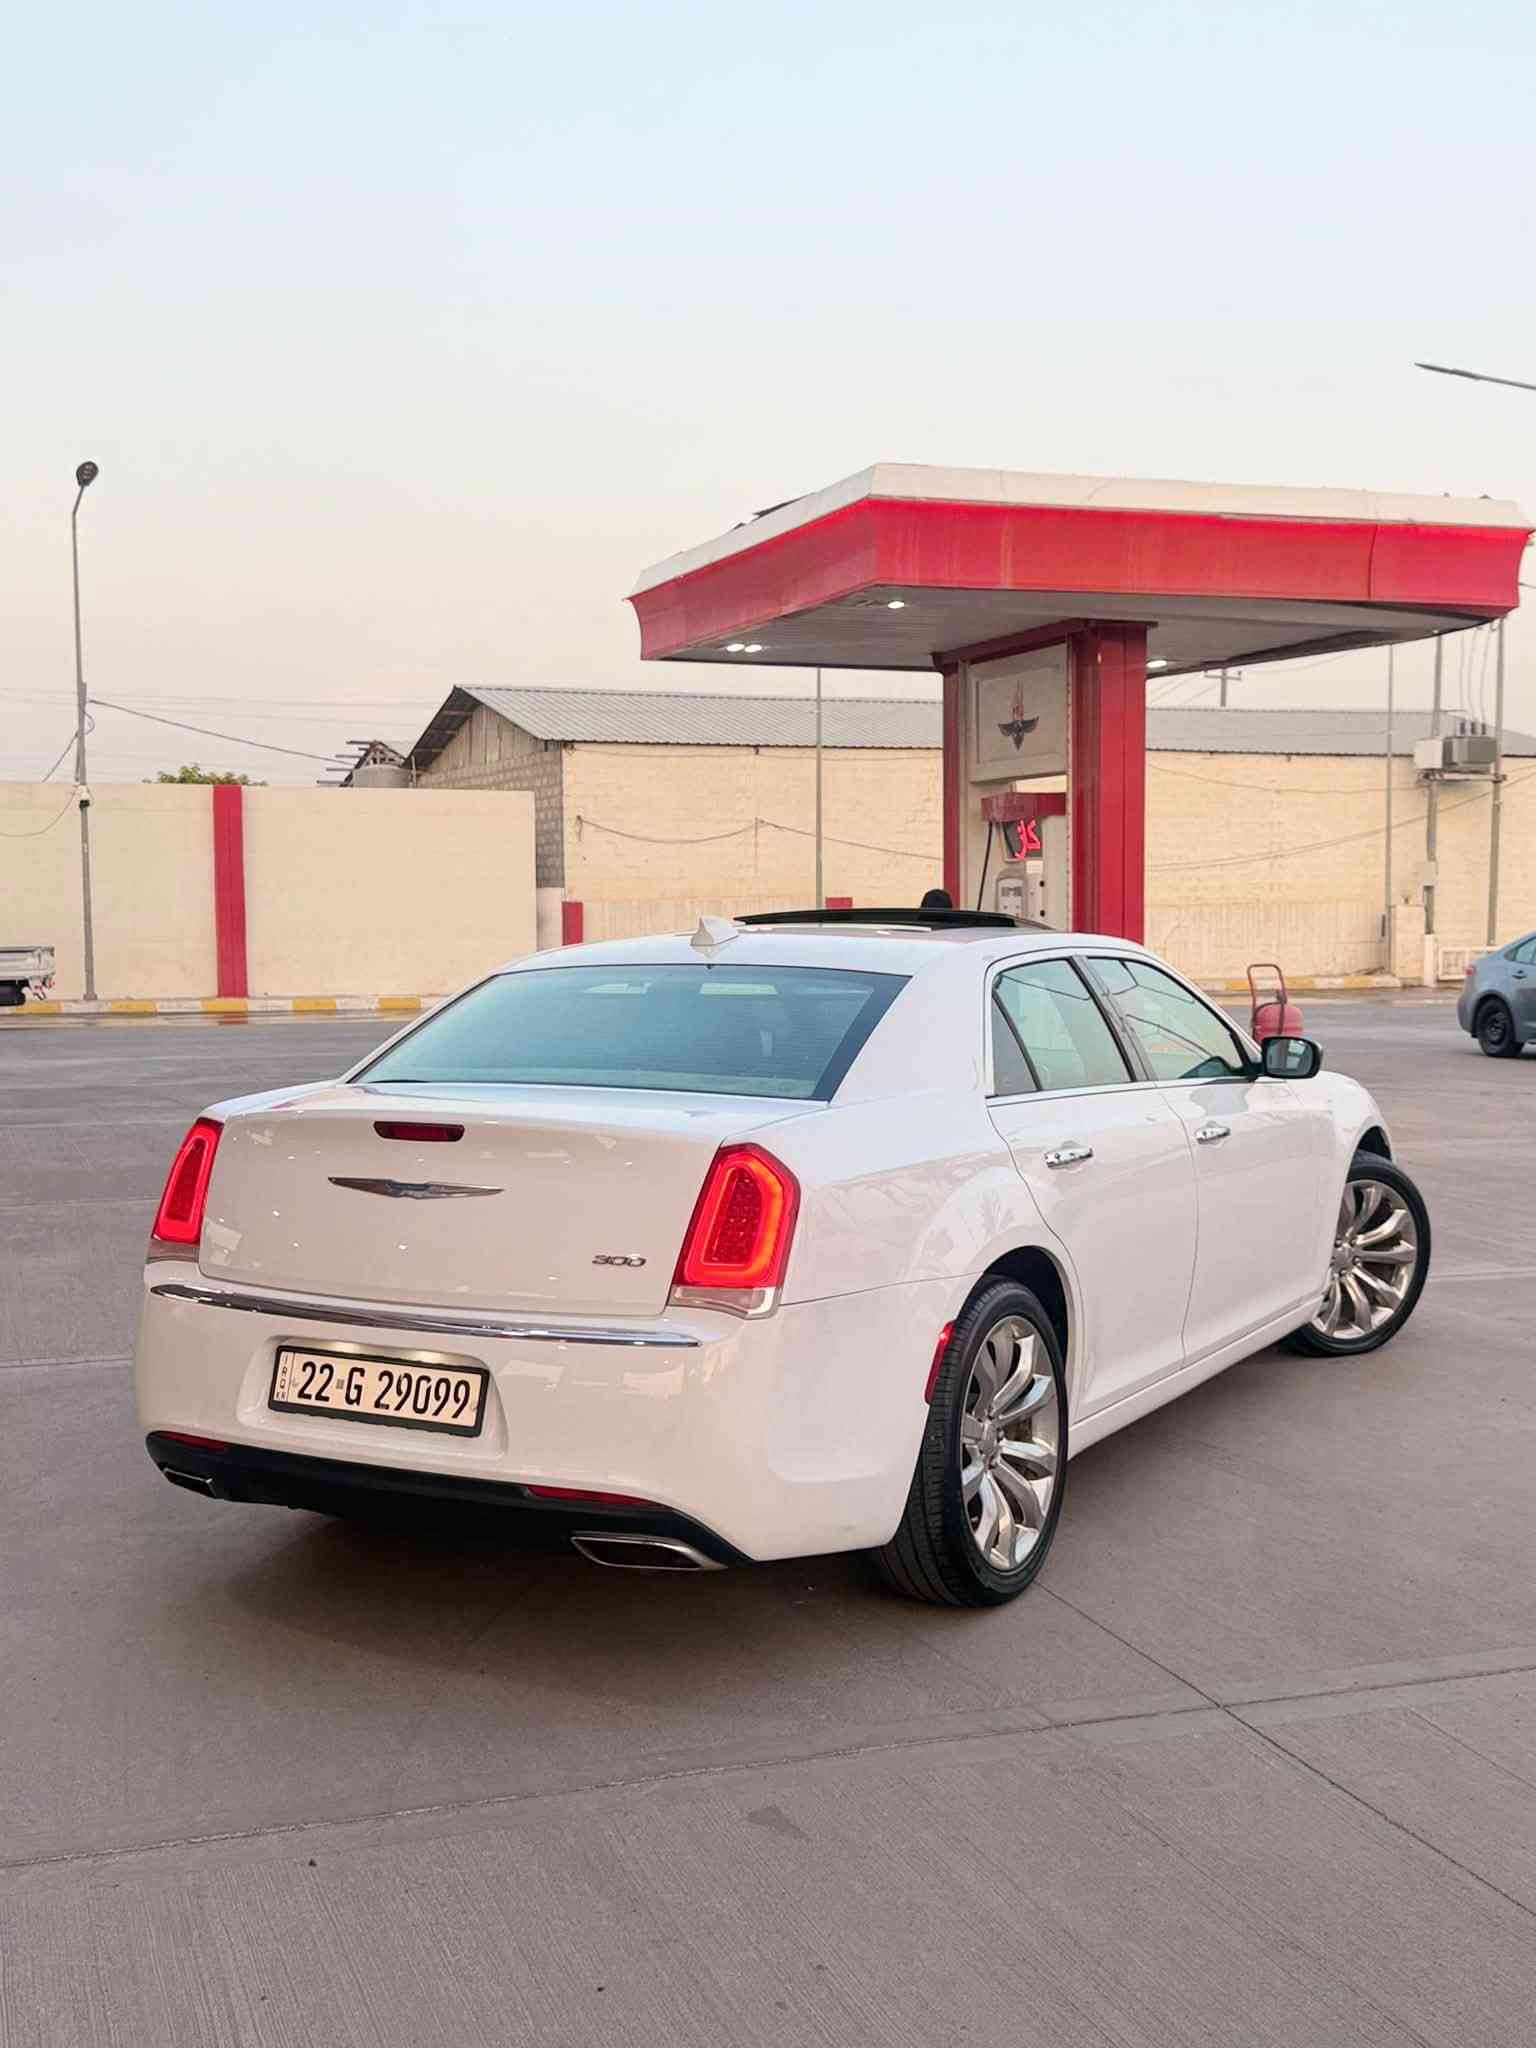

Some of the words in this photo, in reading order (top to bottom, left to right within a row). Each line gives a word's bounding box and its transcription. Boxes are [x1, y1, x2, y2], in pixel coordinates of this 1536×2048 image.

[592, 1254, 646, 1267] 300
[297, 1361, 334, 1402] 22
[345, 1367, 365, 1405] G
[374, 1370, 471, 1419] 29099
